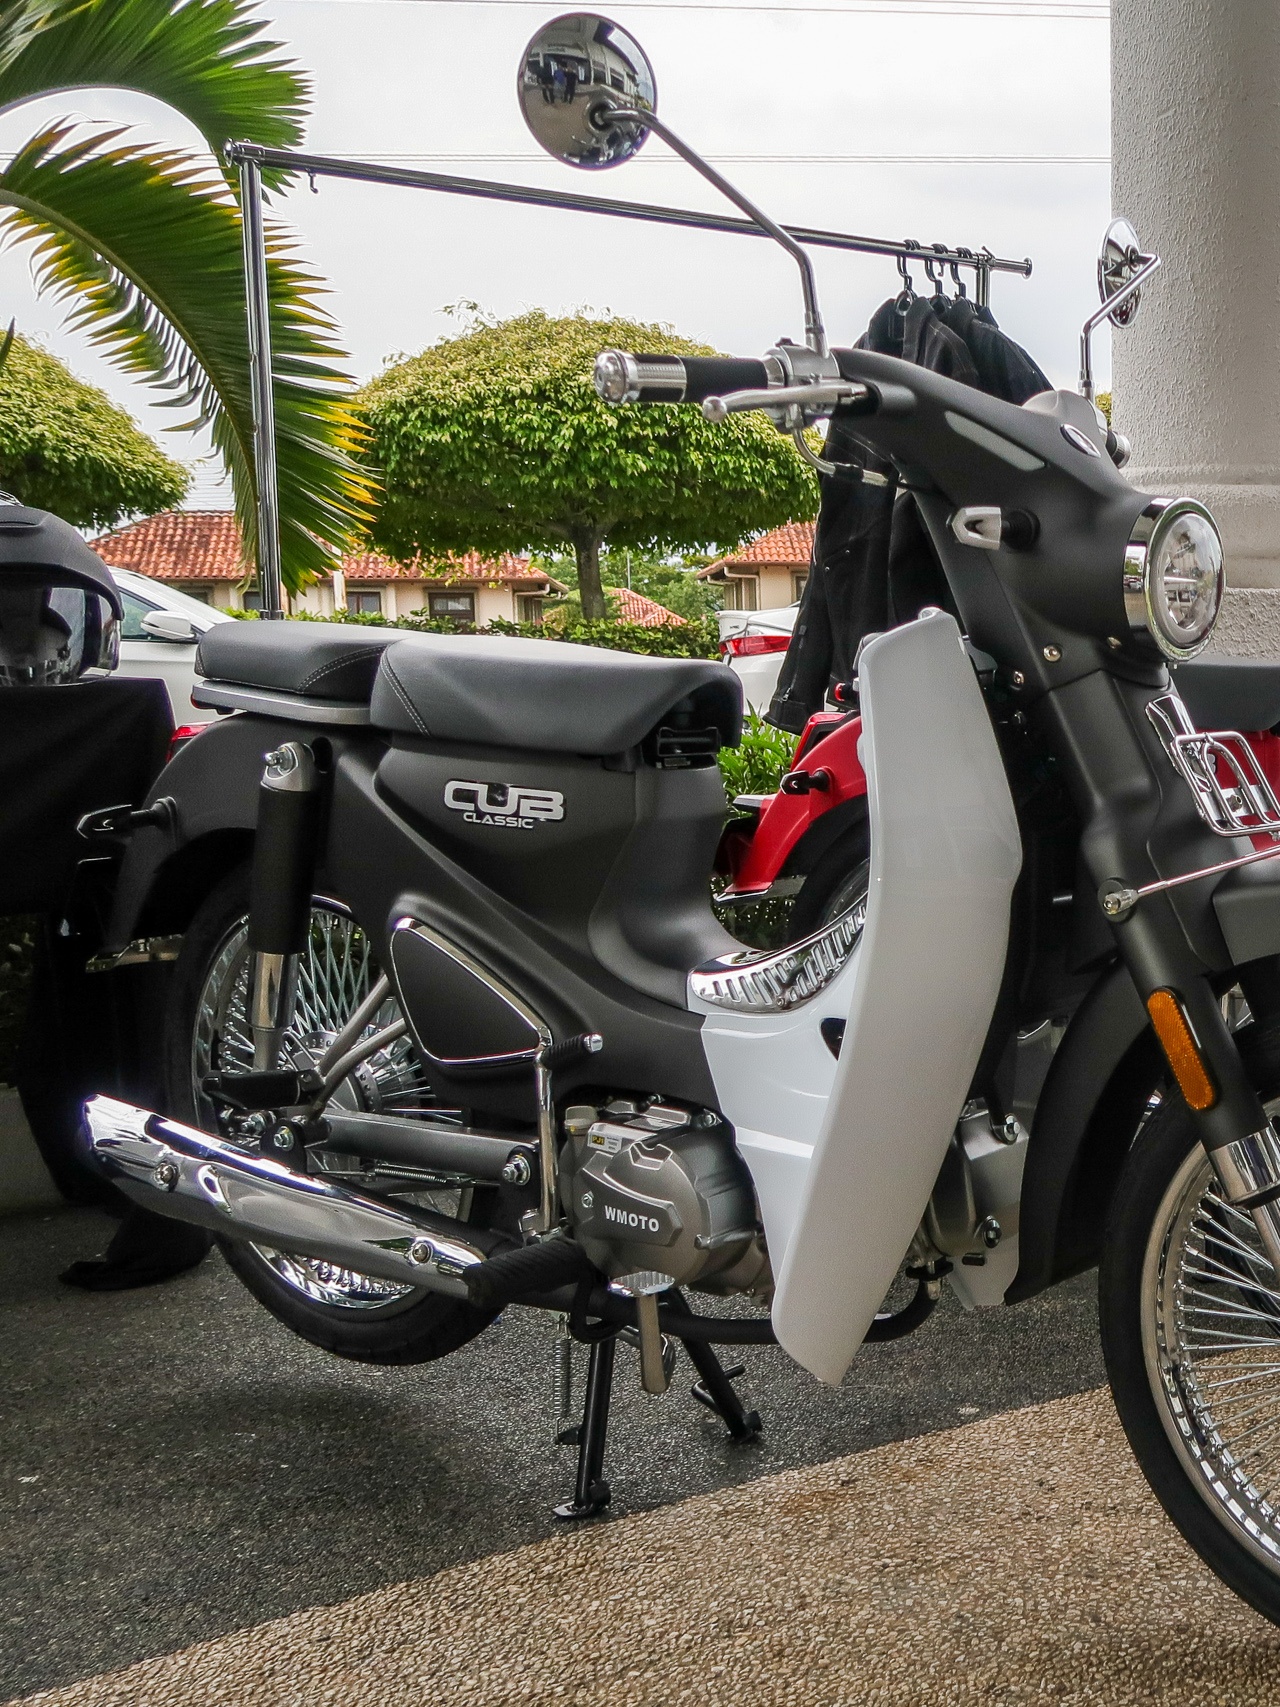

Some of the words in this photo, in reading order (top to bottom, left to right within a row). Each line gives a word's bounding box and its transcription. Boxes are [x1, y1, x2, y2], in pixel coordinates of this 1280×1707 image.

[444, 780, 564, 820] CUB
[463, 812, 534, 829] CLASSIC
[604, 1205, 660, 1232] WMOTO
